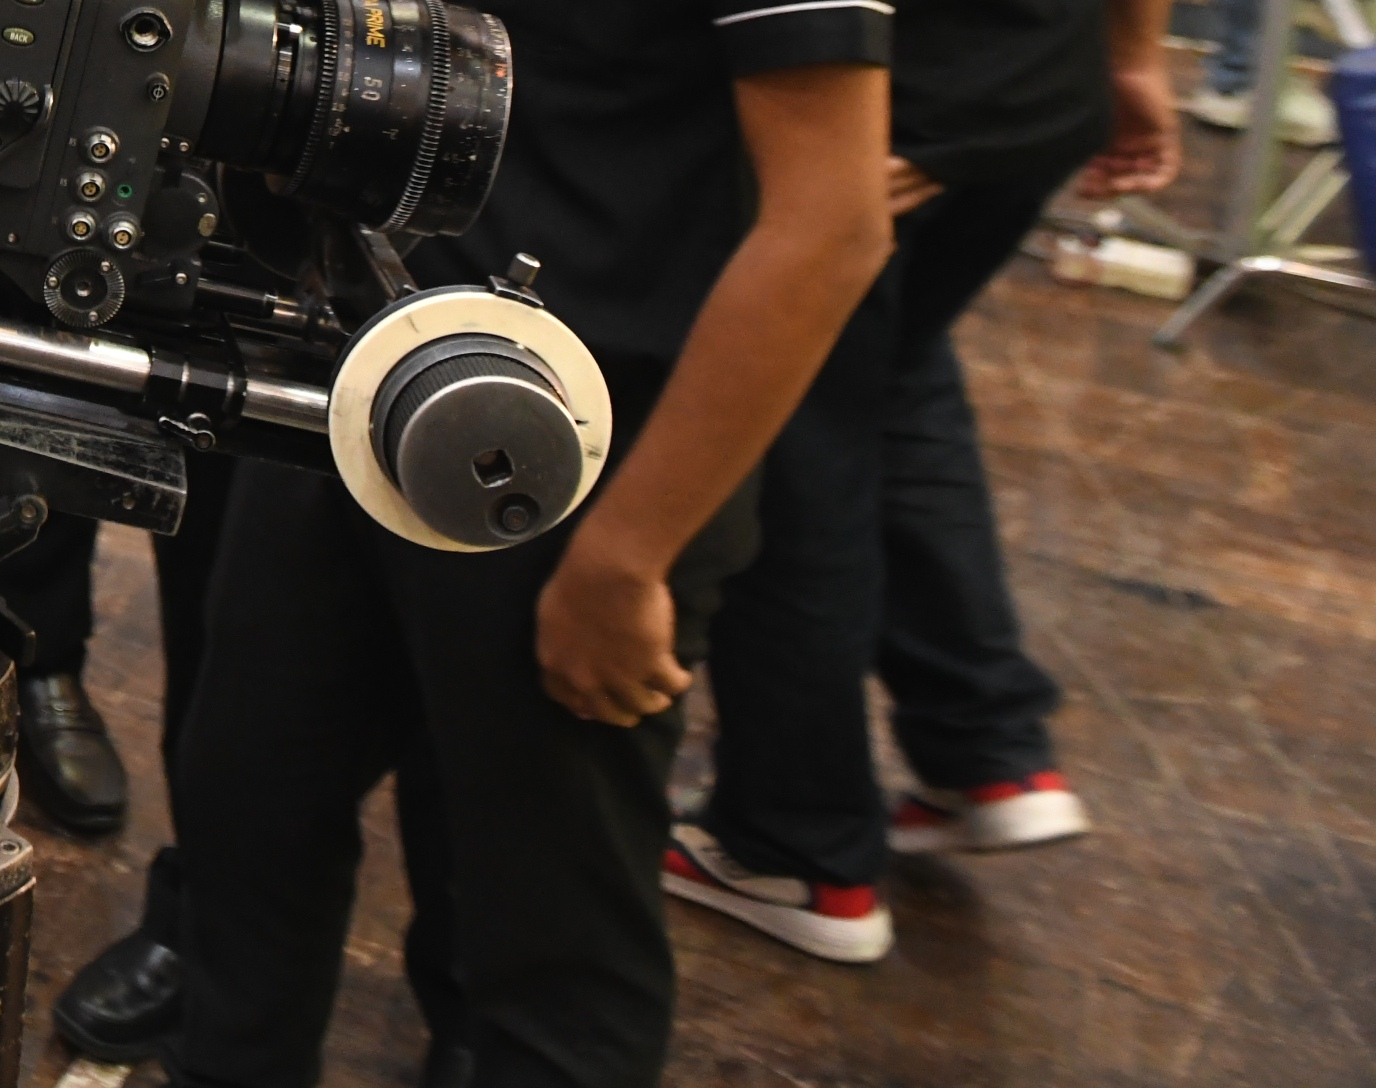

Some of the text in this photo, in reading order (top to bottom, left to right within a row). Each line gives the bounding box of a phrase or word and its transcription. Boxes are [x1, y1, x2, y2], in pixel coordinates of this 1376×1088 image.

[9, 32, 28, 43] BACK
[366, 9, 386, 48] PRIME
[361, 76, 383, 101] 50
